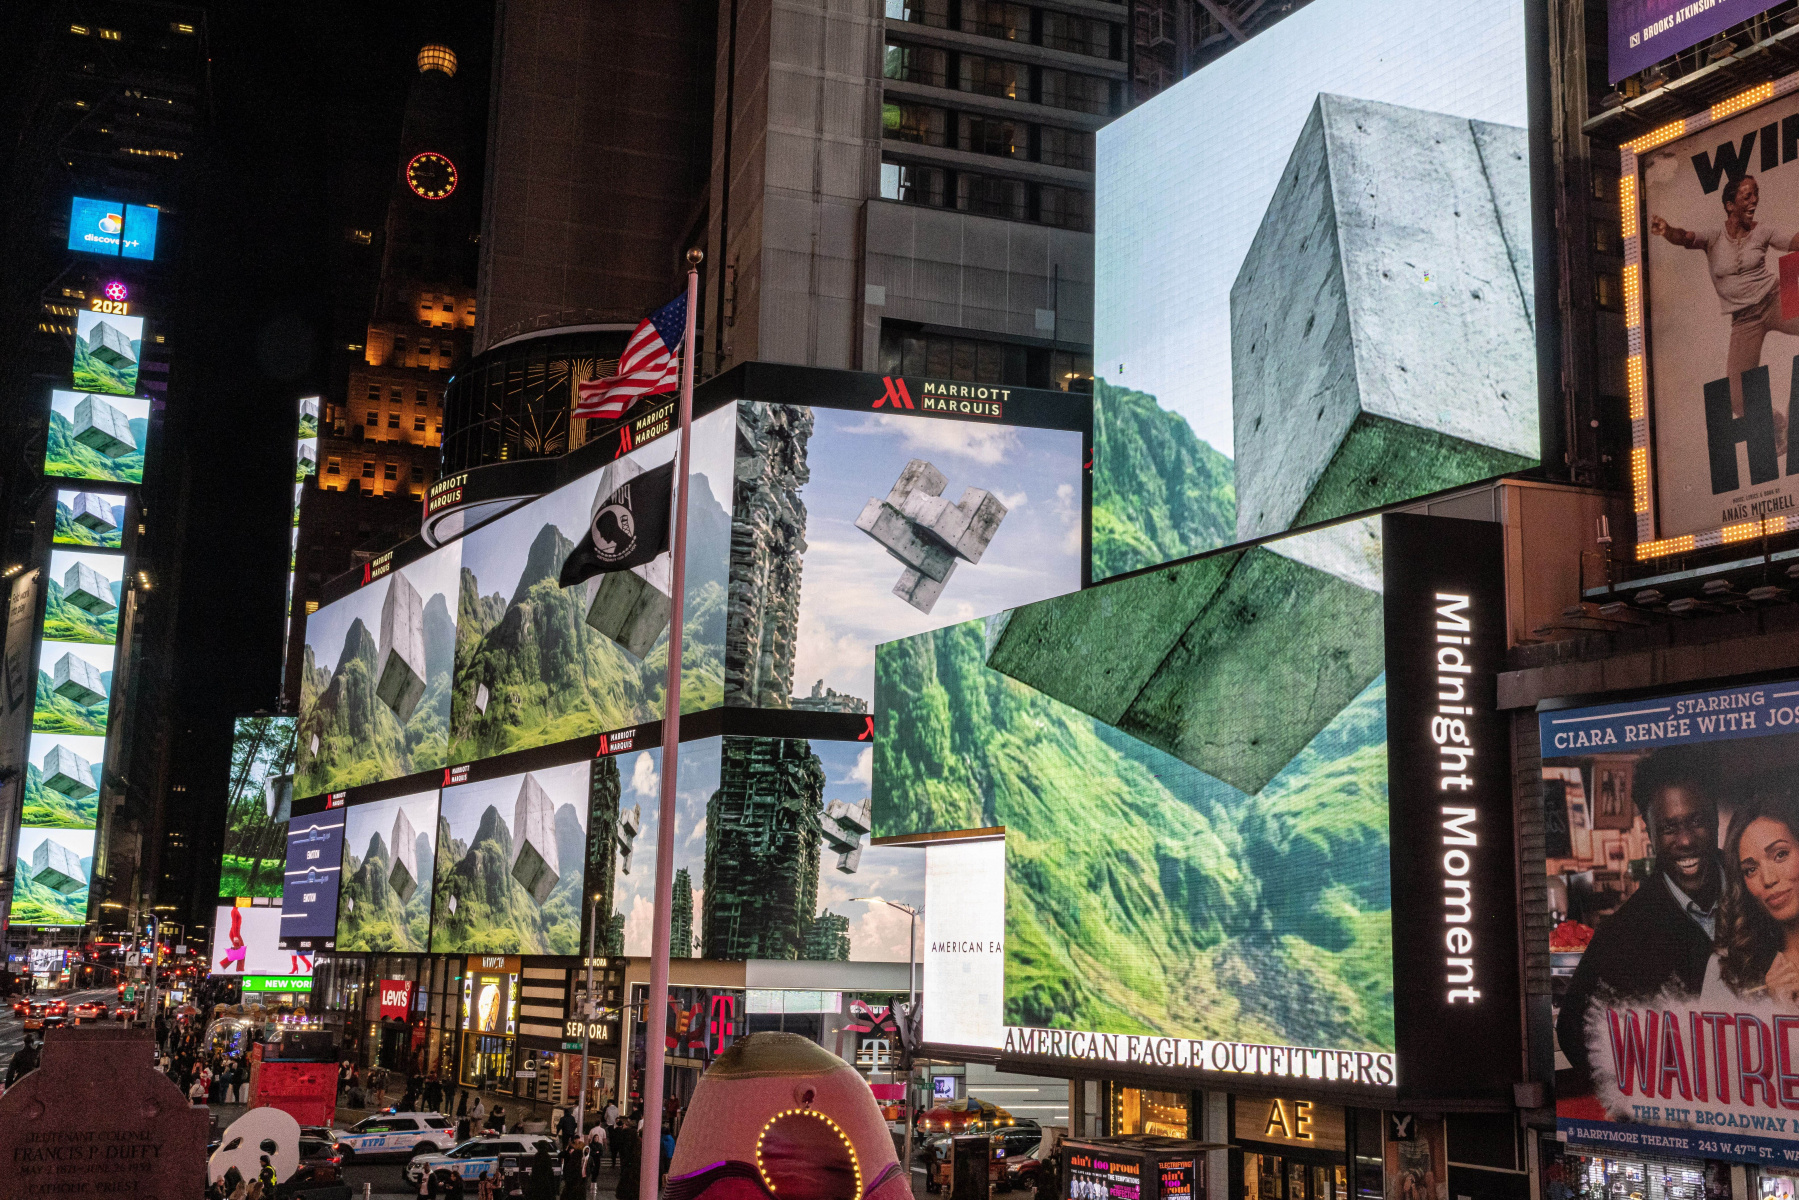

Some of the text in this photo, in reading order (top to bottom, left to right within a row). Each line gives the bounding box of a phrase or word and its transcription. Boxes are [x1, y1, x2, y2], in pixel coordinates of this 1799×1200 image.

[1643, 14, 1674, 41] BROOKS
[84, 233, 140, 248] discovery+
[92, 298, 129, 316] 2021
[924, 382, 1011, 401] MARRIOTT
[636, 402, 675, 431] MARRIOTT
[924, 398, 1000, 416] MARQUIS
[635, 420, 669, 445] MARQUIS
[1703, 354, 1799, 496] H
[430, 474, 469, 498] MARRIOTT
[429, 490, 461, 512] MARQUIS
[1722, 494, 1796, 522] ANAÏS MITCHELL
[1676, 691, 1765, 715] STARRING
[1554, 728, 1618, 749] CIARA
[1625, 714, 1691, 743] RENÉE
[1696, 711, 1757, 734] WITH
[1431, 592, 1481, 1004] Midnight Moment
[931, 940, 983, 953] AMERICAN
[584, 958, 607, 967] SEHORA
[265, 980, 288, 988] NEW
[862, 1039, 890, 1075] T
[1004, 1027, 1394, 1086] AMERICAN EAGLE OUTFITTERS
[1264, 1098, 1313, 1141] AE
[1632, 1105, 1660, 1120] THE
[1664, 1107, 1690, 1123] HIT
[1695, 1109, 1788, 1133] BROADWAY
[13, 1146, 83, 1162] FRANCIS
[105, 1143, 165, 1159] DUFFY
[361, 1138, 385, 1148] NYPD
[1576, 1127, 1639, 1144] BARRYMORE
[1640, 1135, 1689, 1149] THEATRE
[1698, 1140, 1718, 1152] 243
[1720, 1142, 1732, 1154] W.
[1759, 1146, 1775, 1159] ST.
[464, 1164, 490, 1174] NYPD
[1071, 1155, 1140, 1175] ain't too proud
[1162, 1171, 1184, 1181] ain't
[1165, 1180, 1181, 1188] too
